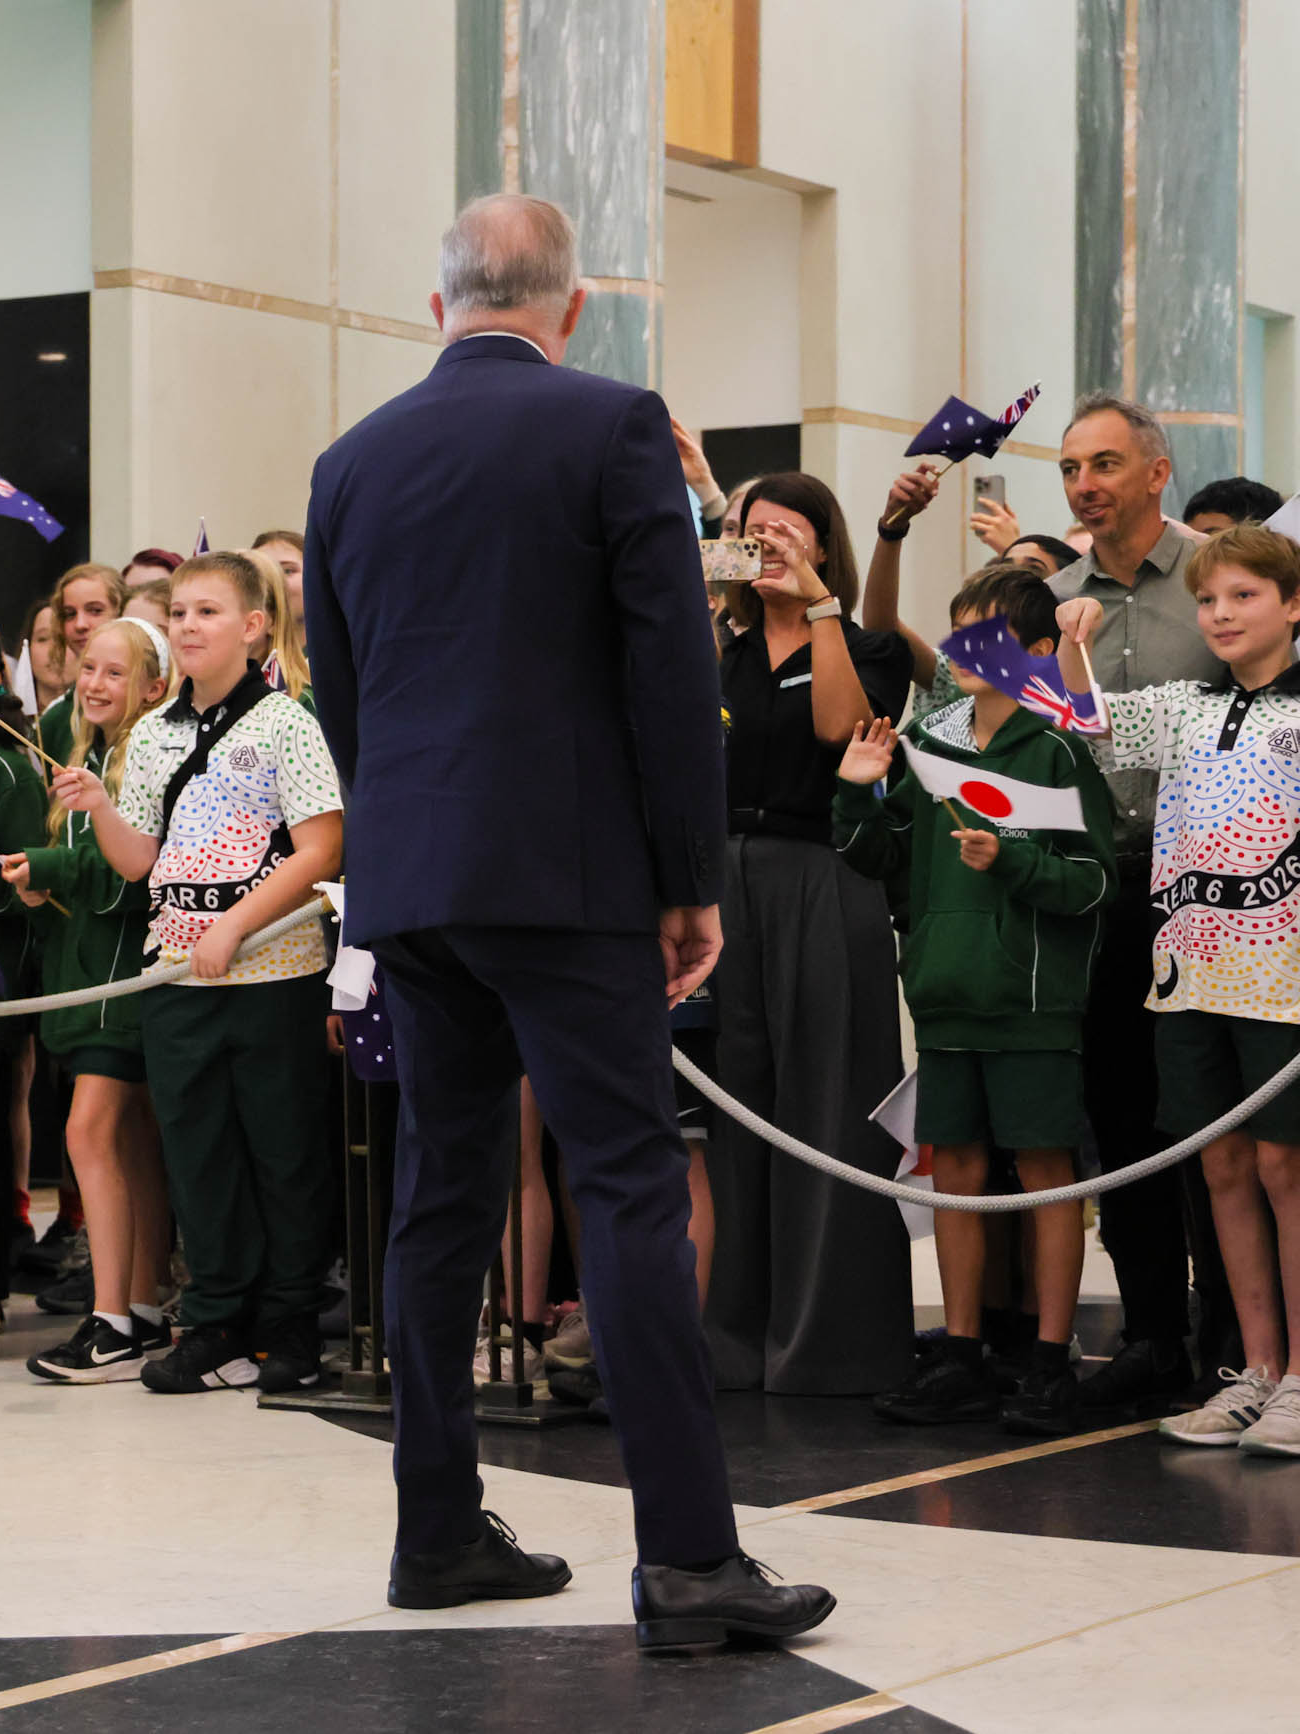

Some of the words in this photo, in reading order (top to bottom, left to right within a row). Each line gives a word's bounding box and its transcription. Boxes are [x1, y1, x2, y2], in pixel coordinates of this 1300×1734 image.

[999, 828, 1029, 839] SCHOOL
[1151, 876, 1198, 916] YEAR
[1205, 879, 1223, 903] 6
[1239, 855, 1300, 908] 2026
[204, 887, 220, 909] 6
